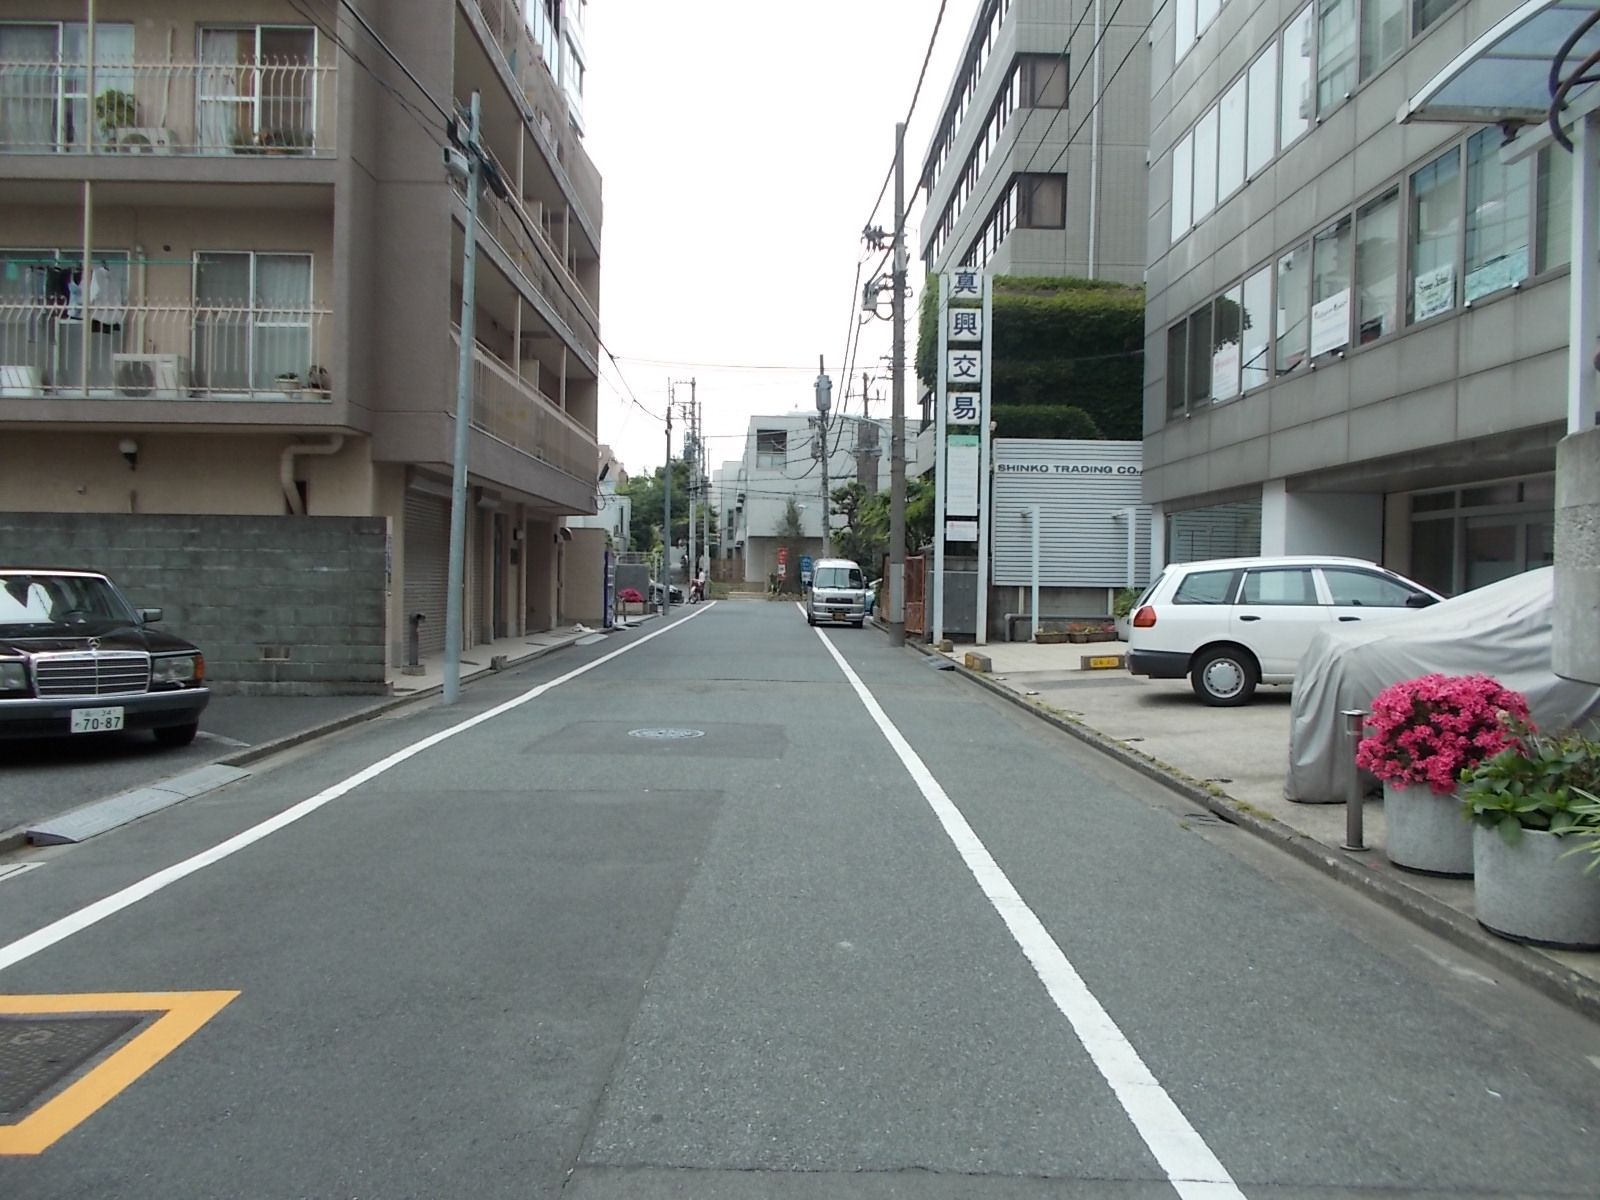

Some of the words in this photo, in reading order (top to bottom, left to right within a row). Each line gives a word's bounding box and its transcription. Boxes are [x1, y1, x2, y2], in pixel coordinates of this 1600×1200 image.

[953, 270, 978, 420] 真興交易
[997, 463, 1049, 473] SHINKO
[1053, 464, 1113, 474] TRADING
[83, 717, 121, 730] 70-87
